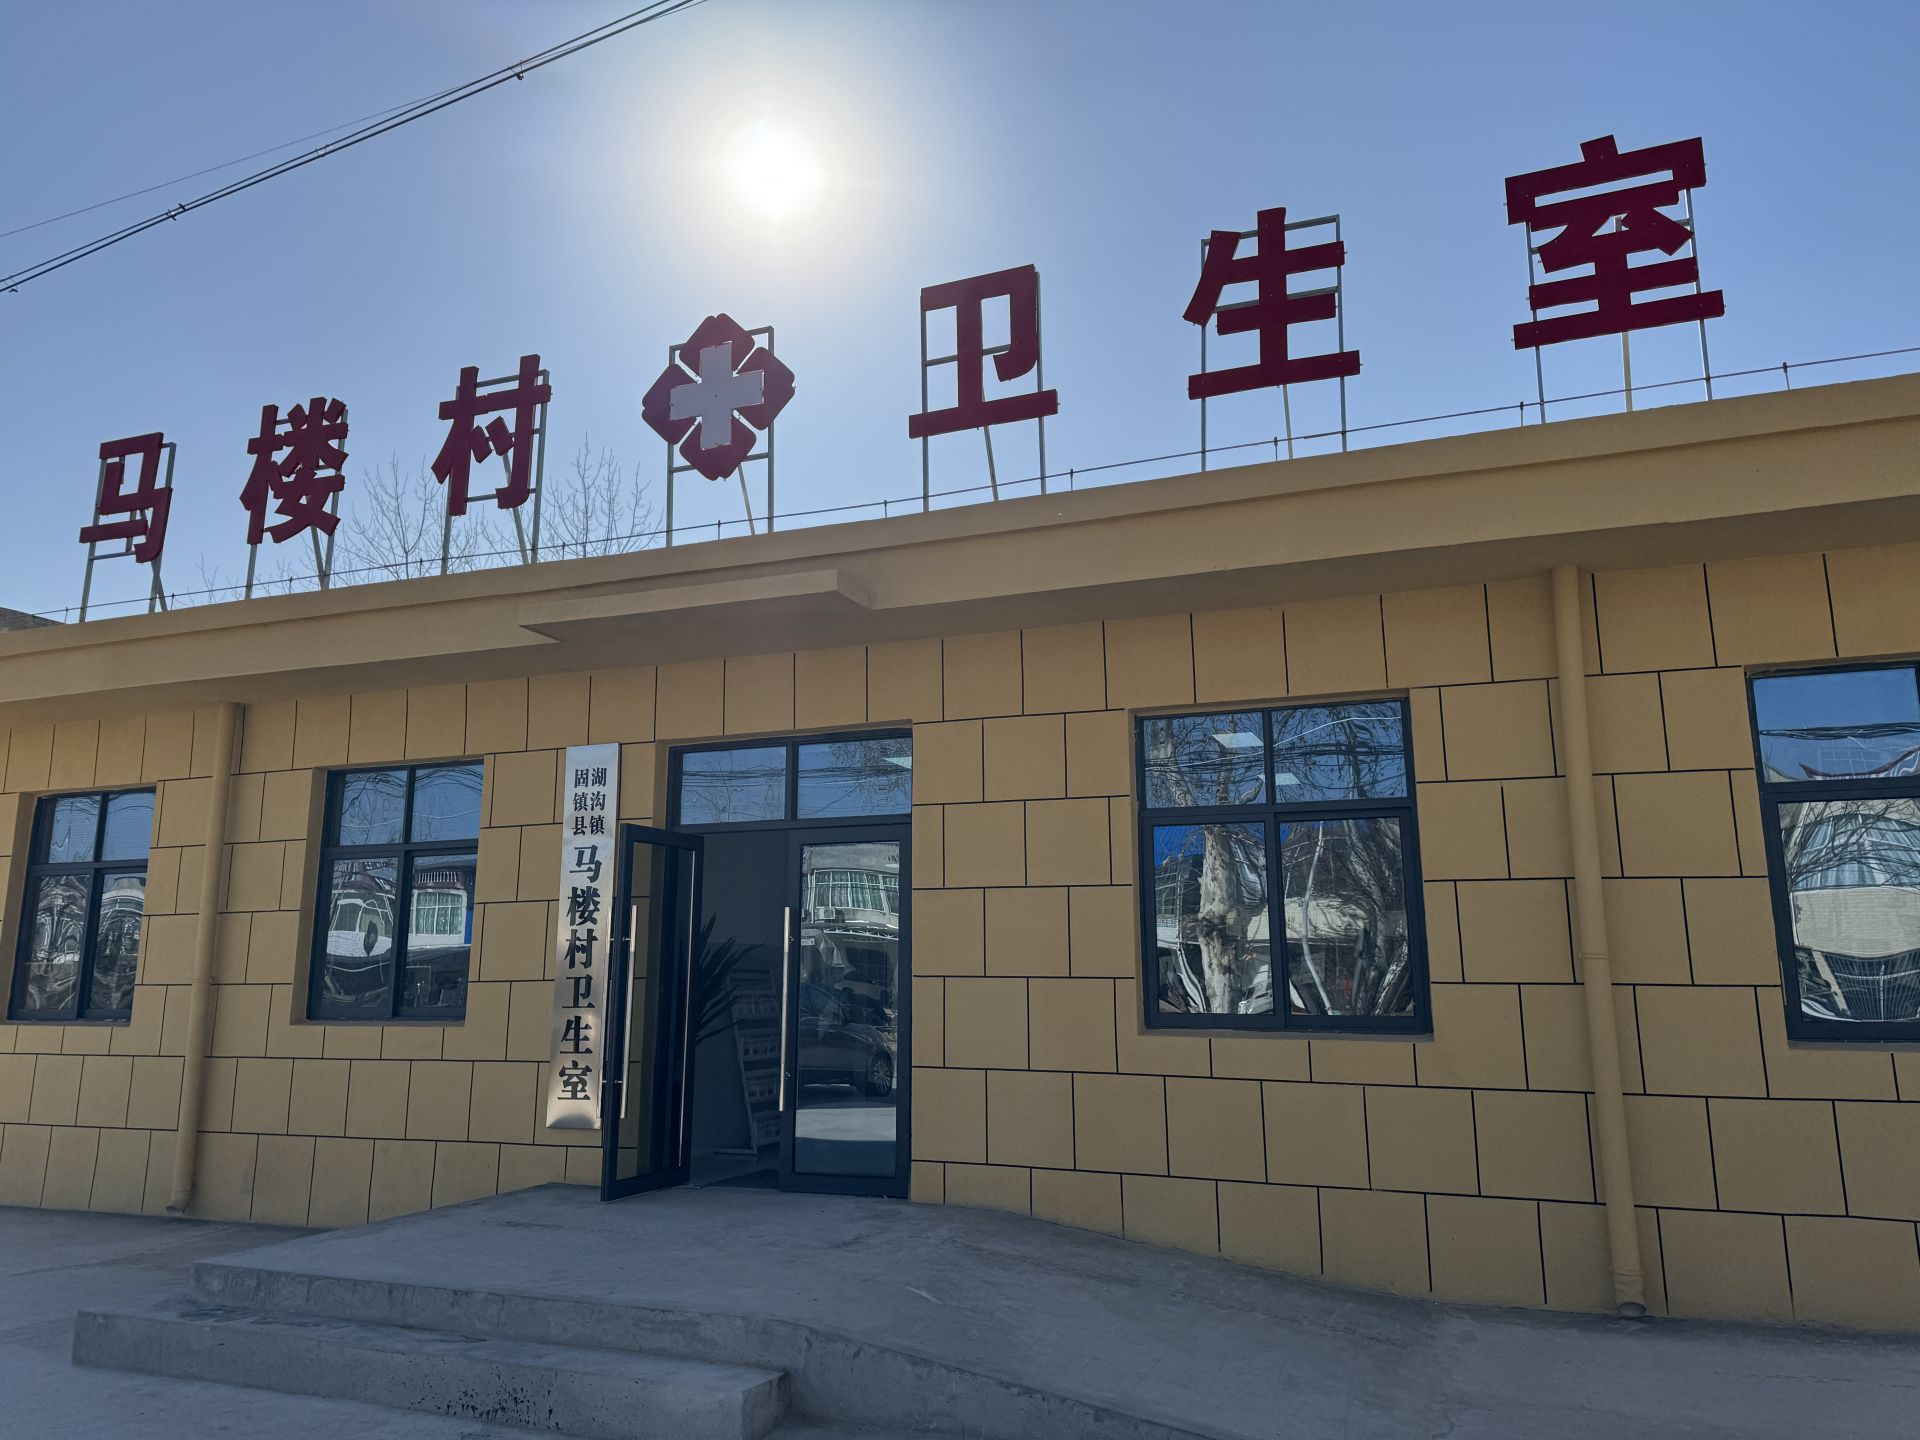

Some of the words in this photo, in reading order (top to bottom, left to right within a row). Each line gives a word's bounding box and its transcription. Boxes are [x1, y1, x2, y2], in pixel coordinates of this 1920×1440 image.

[79, 354, 551, 563] 马楼村
[909, 134, 1725, 440] 卫生室
[571, 768, 590, 836] 固镇县
[589, 767, 608, 836] 湖沟镇
[557, 844, 603, 1101] 马楼村卫生室
